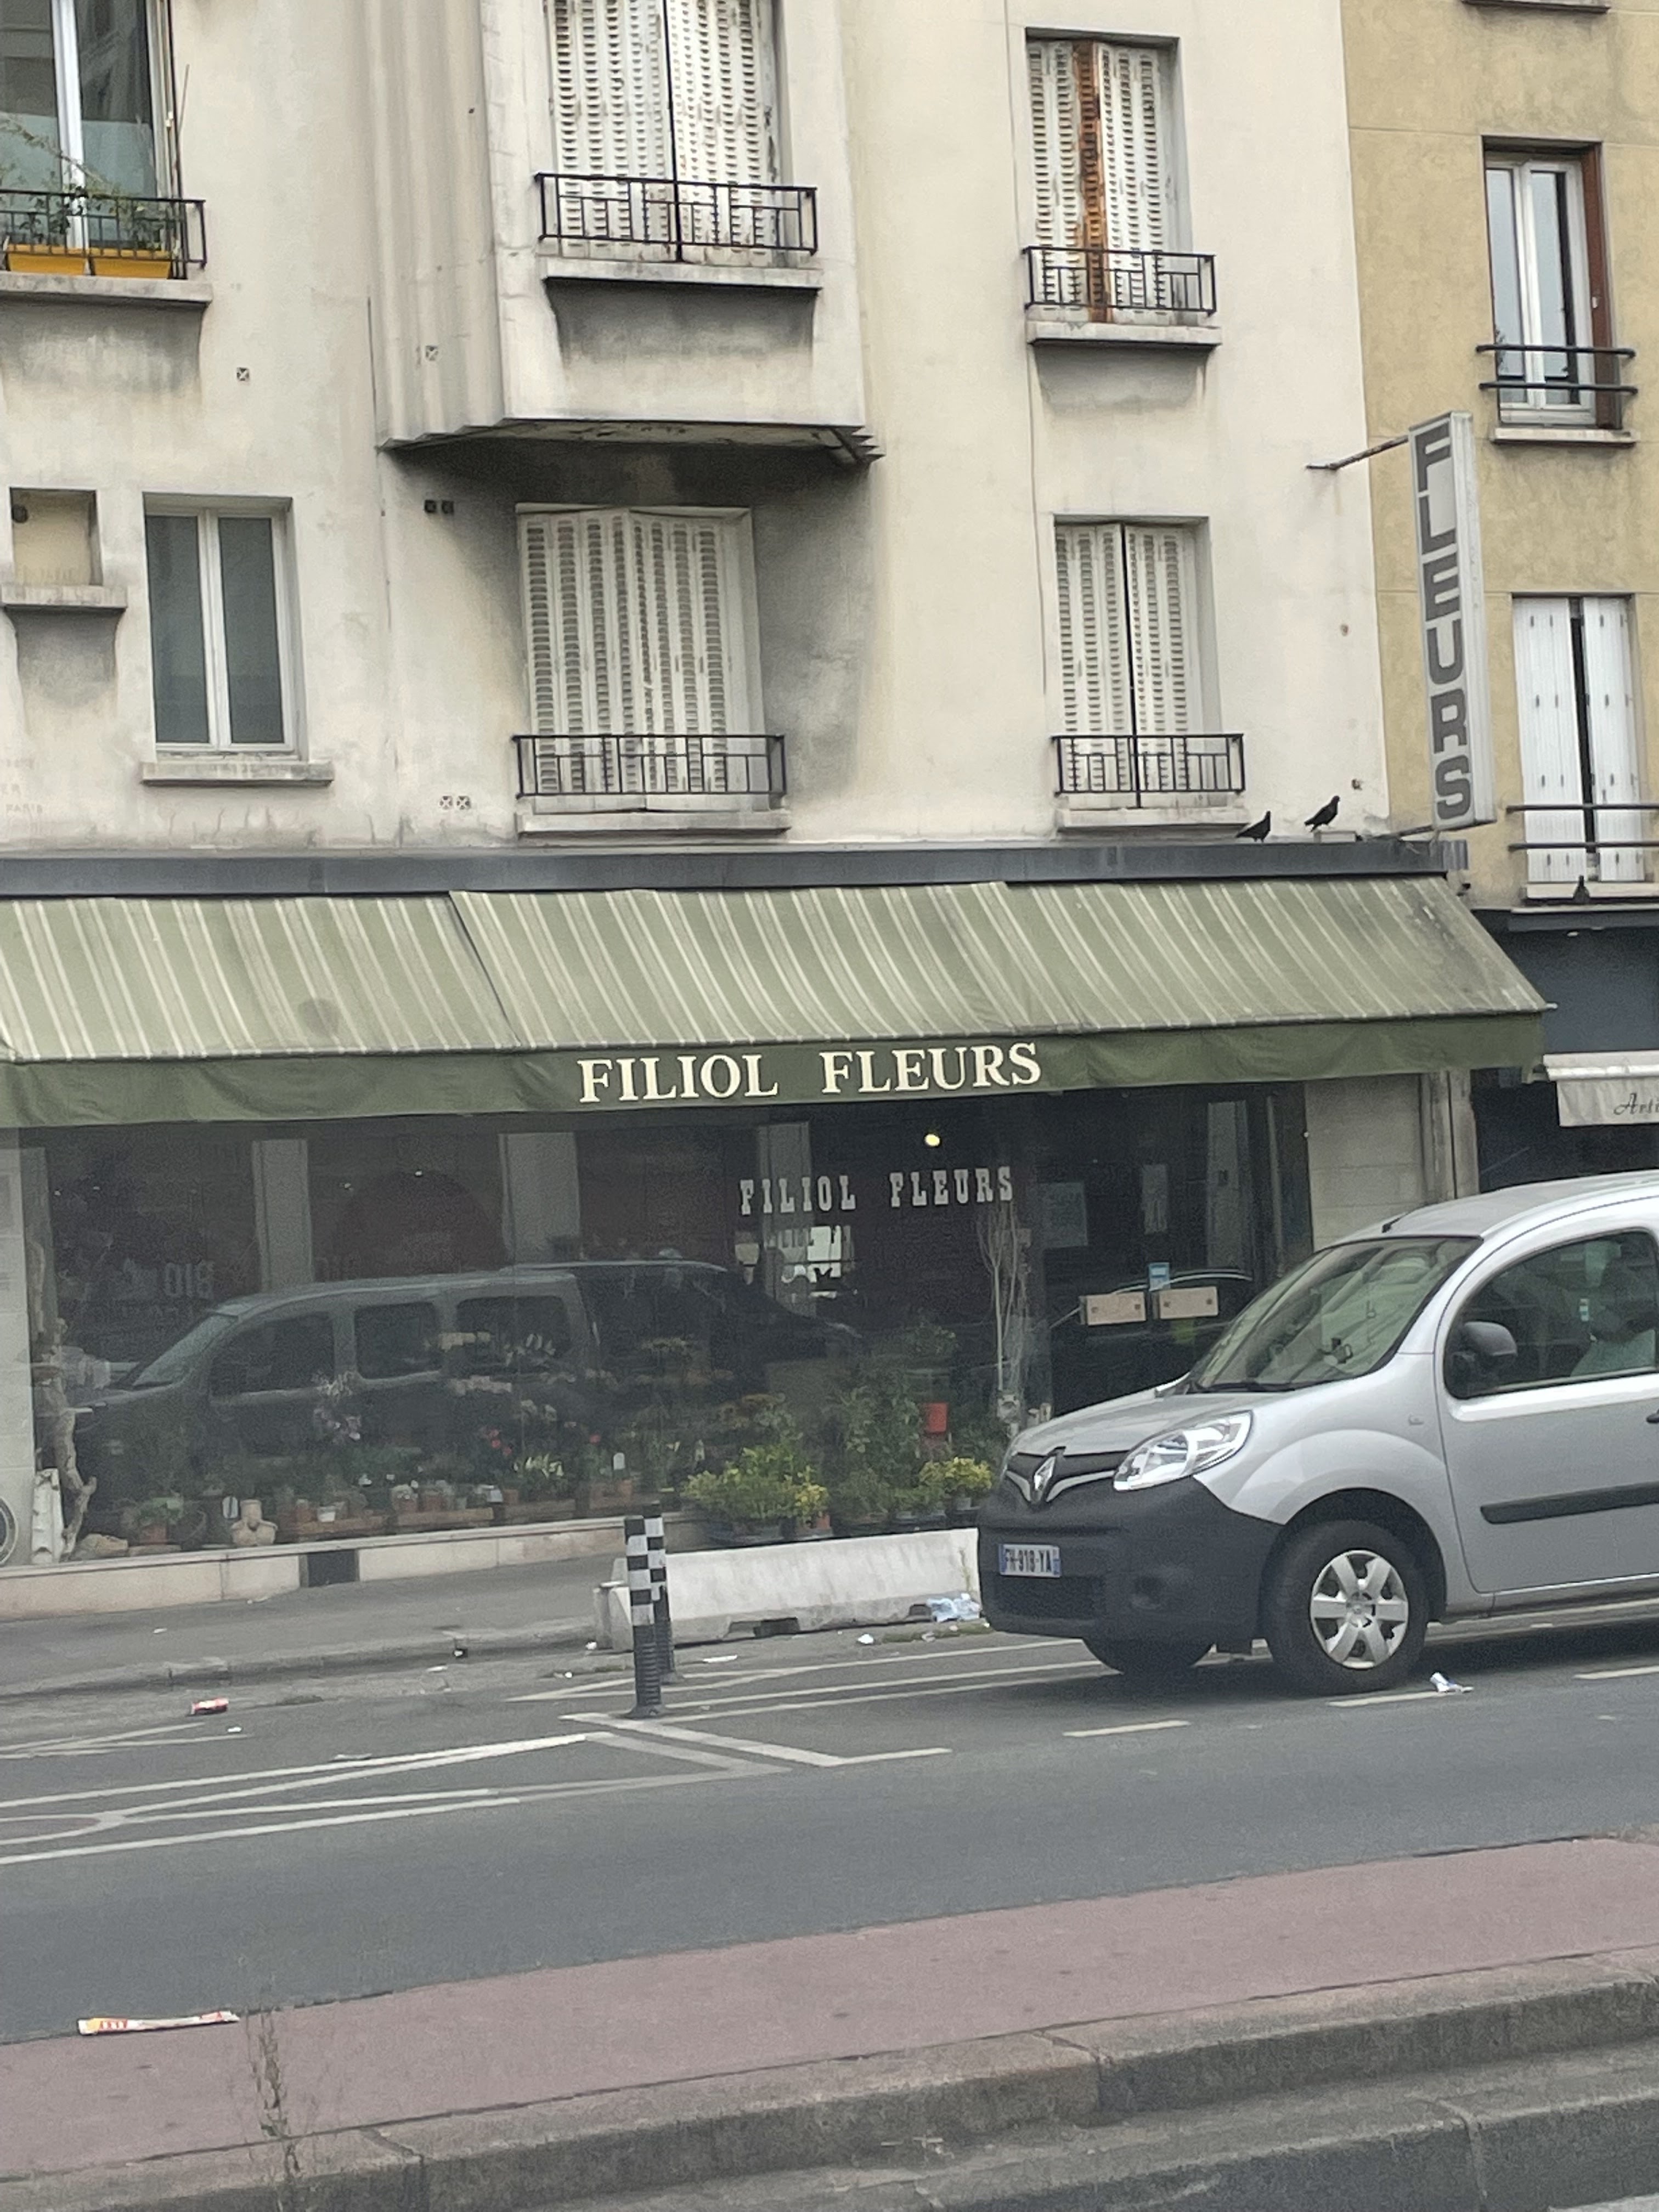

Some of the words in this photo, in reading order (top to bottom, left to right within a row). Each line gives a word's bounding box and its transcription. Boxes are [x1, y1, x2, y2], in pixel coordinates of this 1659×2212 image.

[1414, 420, 1471, 820] FLEURS
[577, 1053, 779, 1104] FILIOL
[820, 1042, 1042, 1094] FLEURS
[740, 1175, 856, 1216] FILIOL
[889, 1165, 1014, 1207] FLEURS
